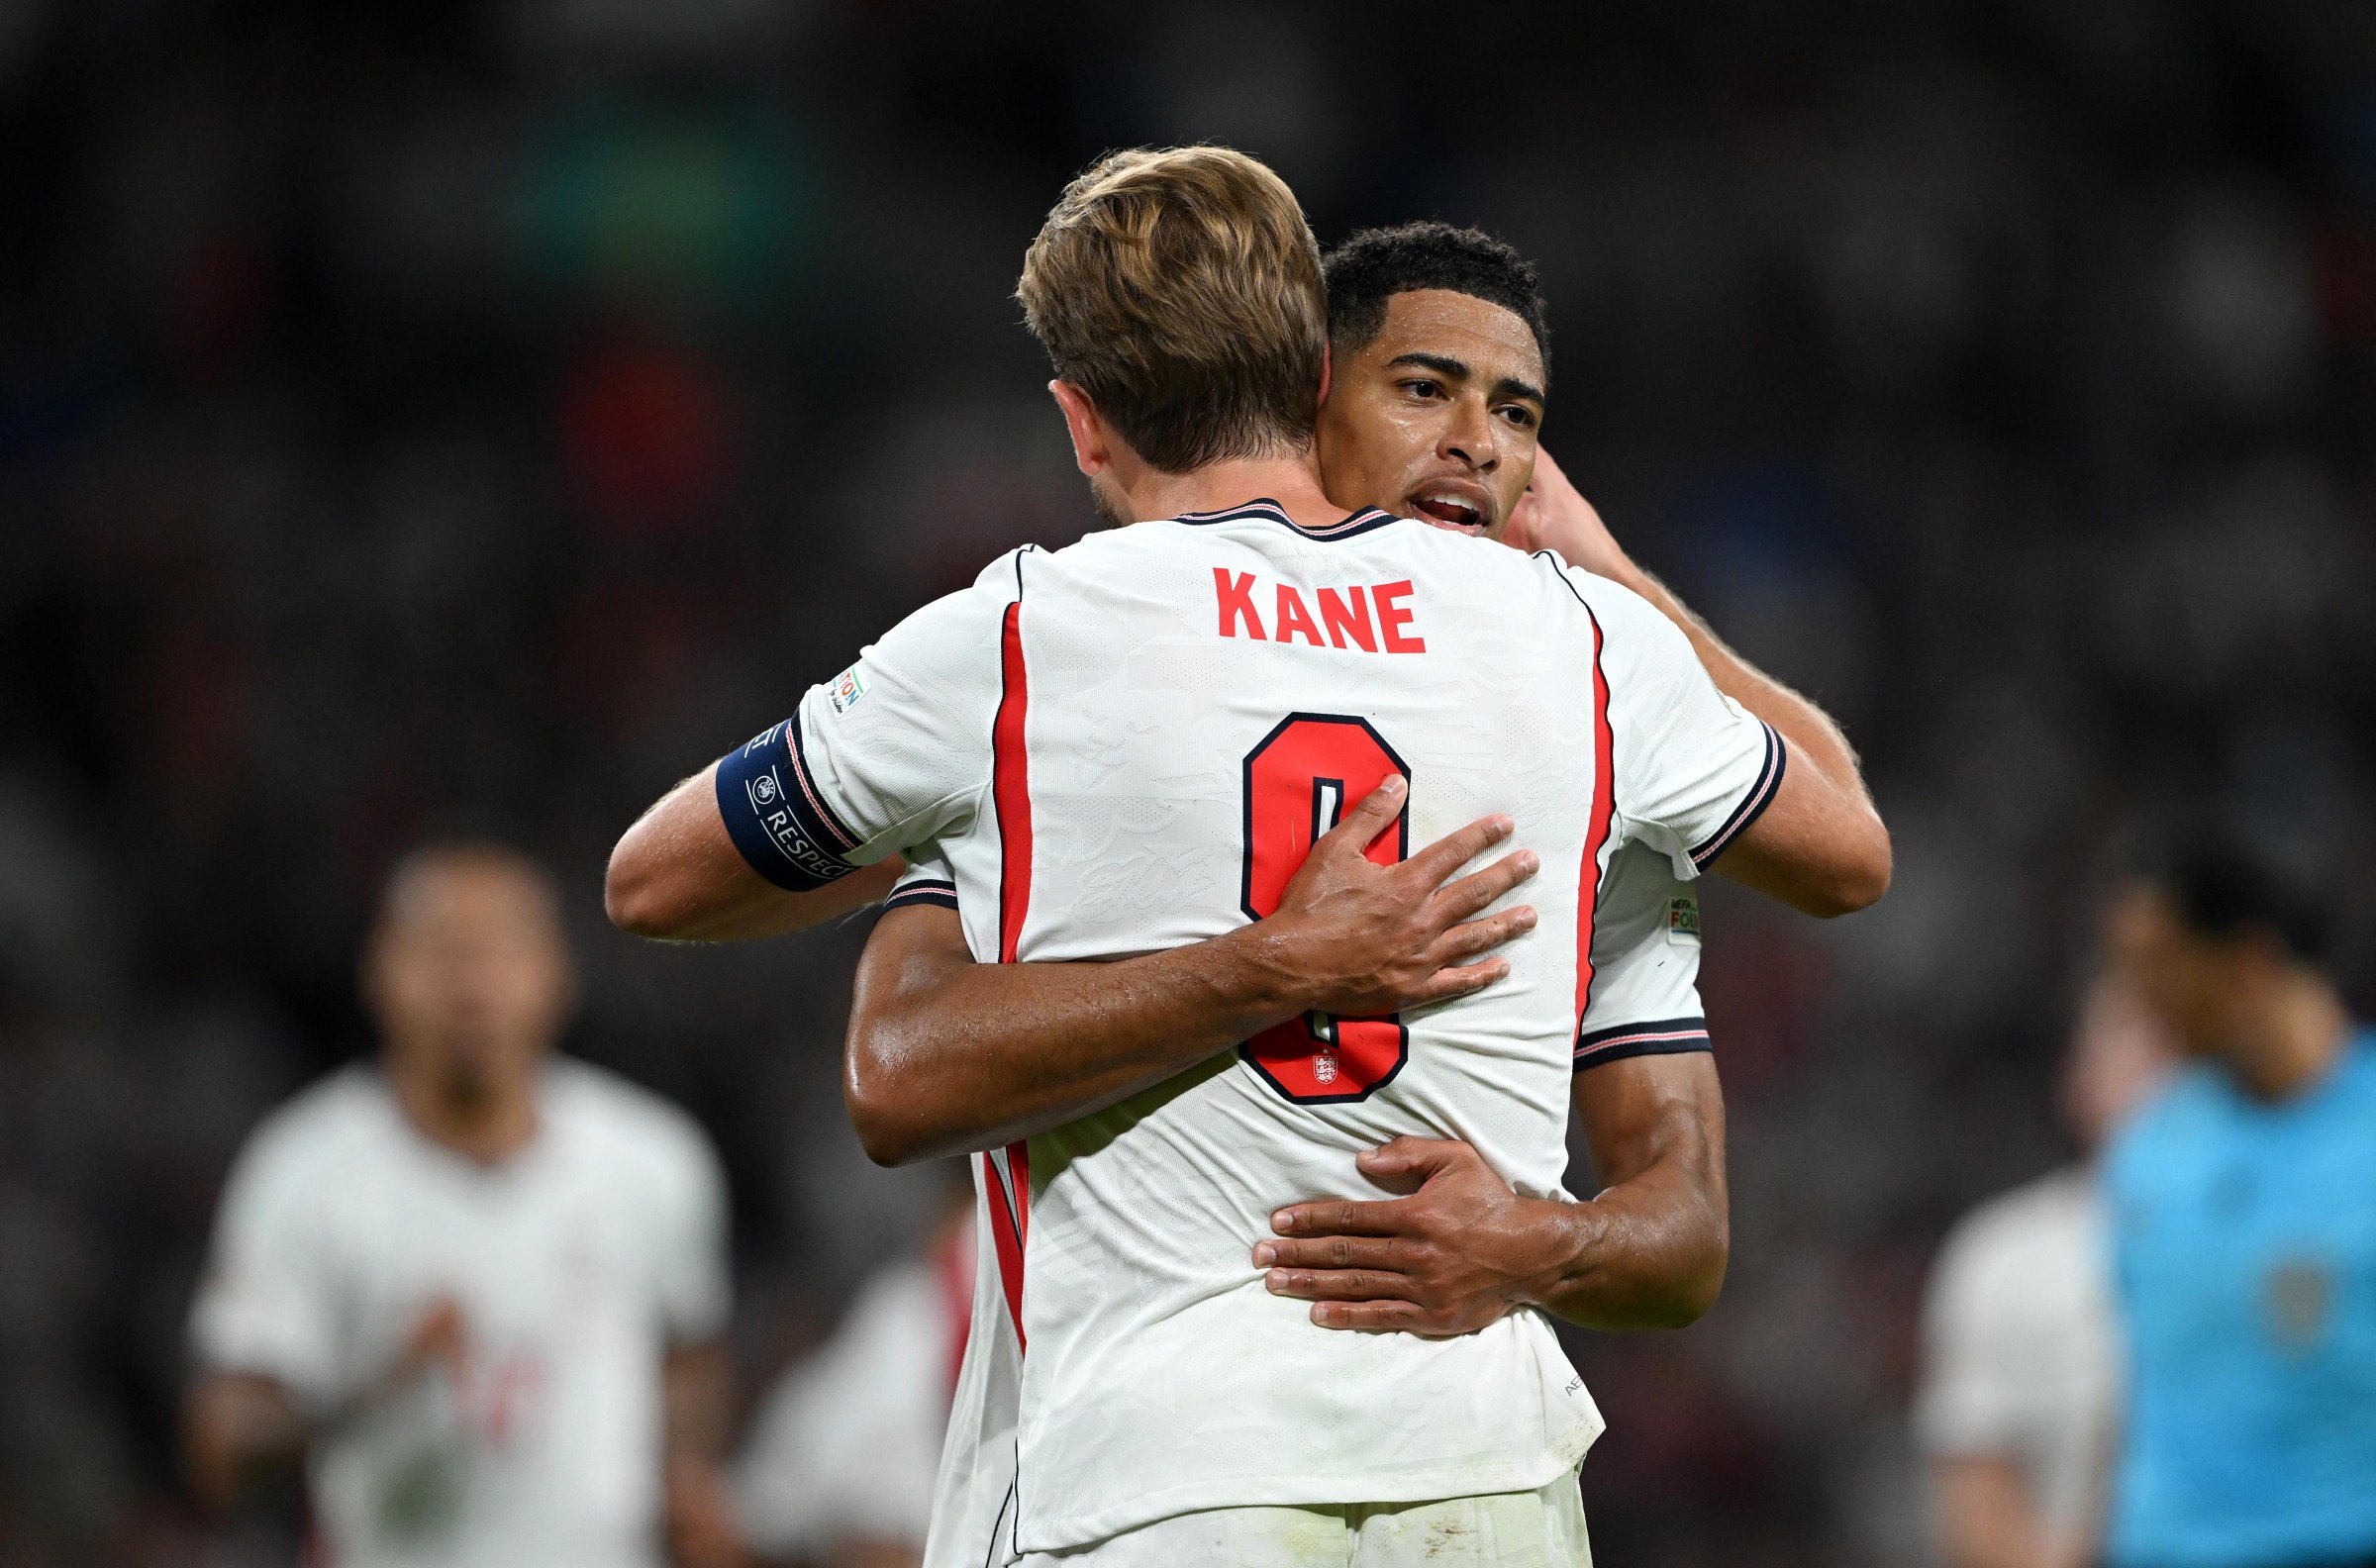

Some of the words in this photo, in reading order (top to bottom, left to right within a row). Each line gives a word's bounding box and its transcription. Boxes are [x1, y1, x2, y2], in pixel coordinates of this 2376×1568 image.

[1213, 567, 1426, 653] KANE
[767, 810, 854, 876] RESPECT
[1670, 912, 1701, 929] FOU
[1565, 1375, 1584, 1397] AE
